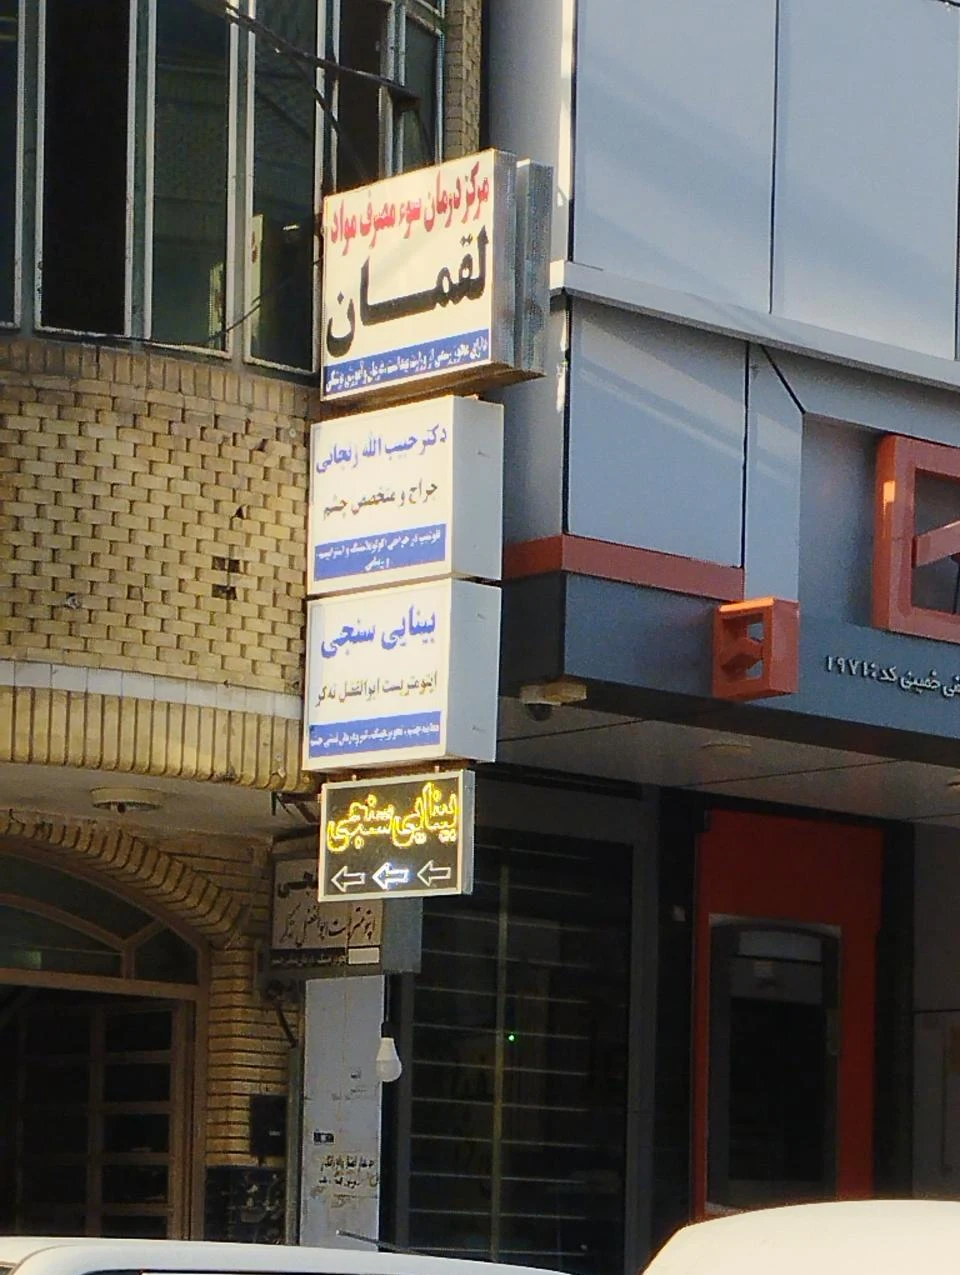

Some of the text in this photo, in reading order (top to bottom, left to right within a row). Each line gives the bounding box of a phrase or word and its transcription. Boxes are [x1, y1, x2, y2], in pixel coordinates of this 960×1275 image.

[360, 190, 396, 249] مصرف
[424, 170, 461, 232] درمان
[461, 161, 489, 224] مرکز
[331, 199, 357, 256] مواد
[326, 224, 490, 358] لقمان
[362, 430, 382, 457] الله
[385, 434, 418, 460] حبیب
[419, 424, 447, 456] دکتر
[408, 477, 438, 504] جراح
[321, 603, 436, 659] بینایی سنجی
[900, 668, 941, 695] خمینی
[326, 782, 460, 853] بینایی سنجی
